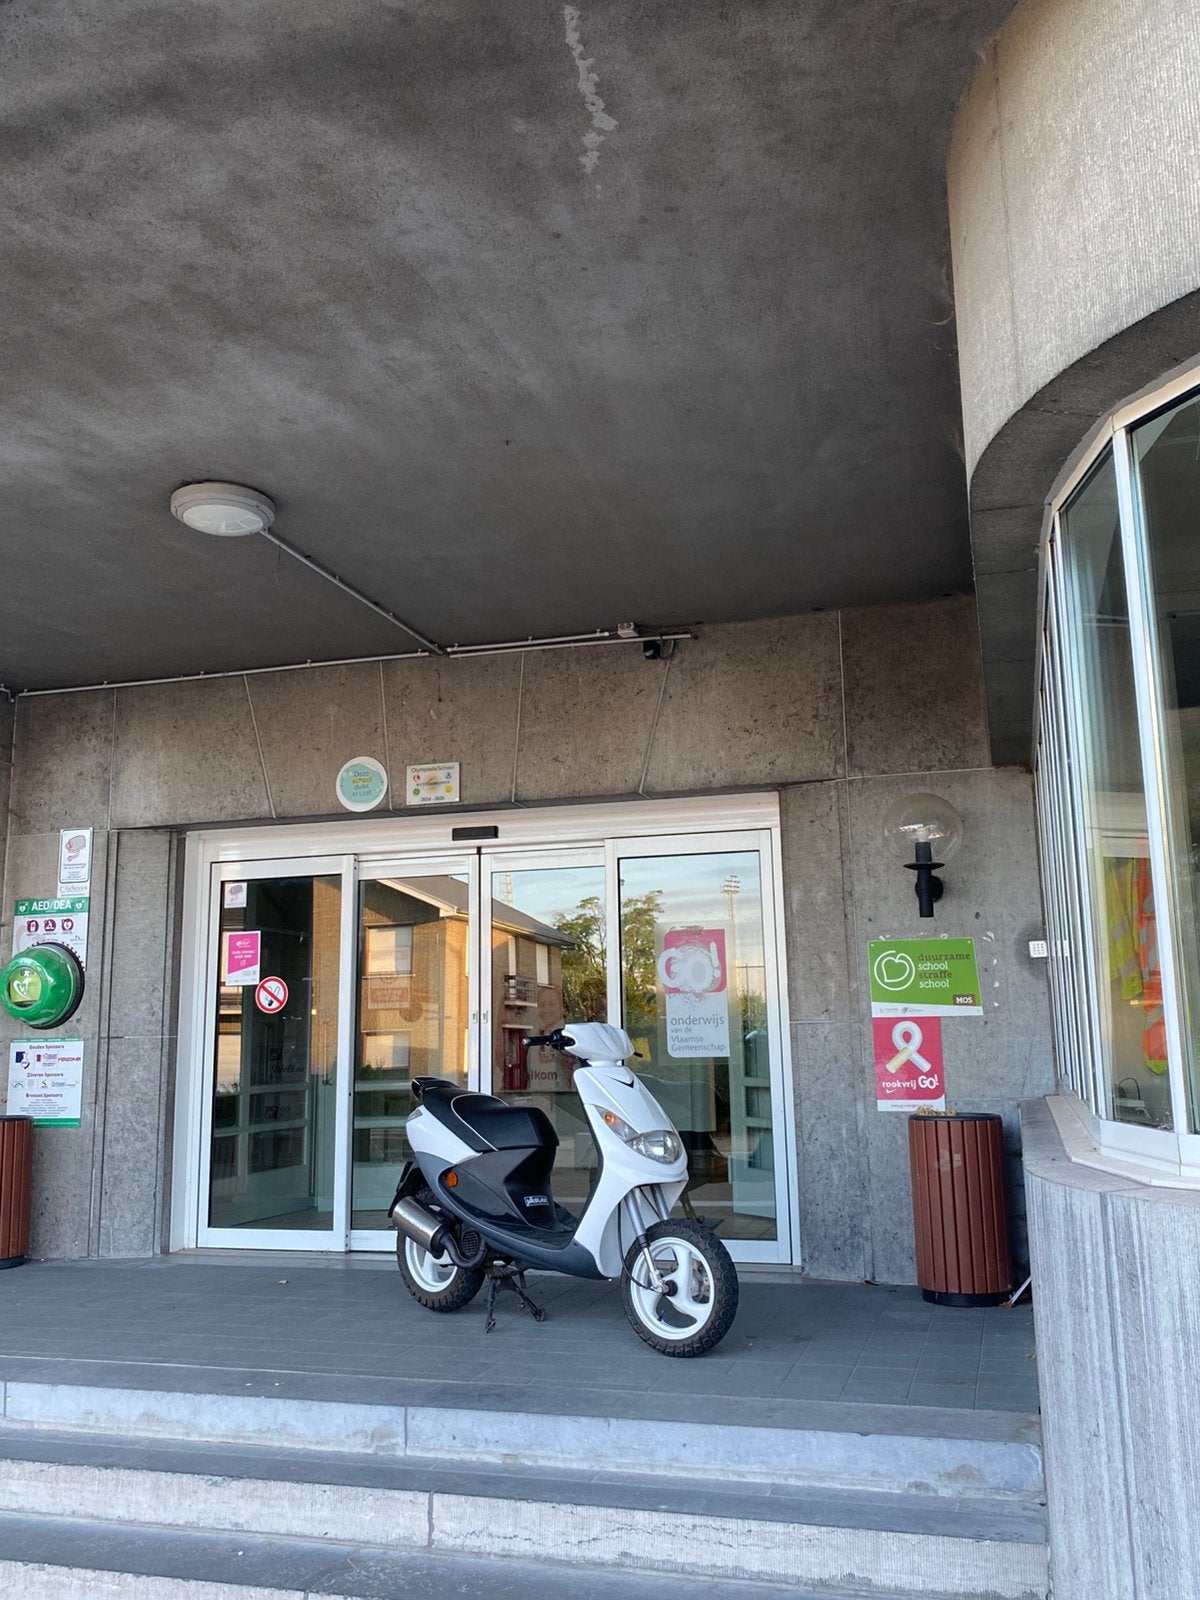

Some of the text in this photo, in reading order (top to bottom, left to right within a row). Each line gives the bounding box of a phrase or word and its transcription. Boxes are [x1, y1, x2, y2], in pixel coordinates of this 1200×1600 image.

[352, 776, 373, 784] school
[31, 900, 72, 911] AED/DEA
[918, 952, 971, 961] duurzame
[918, 961, 948, 970] school
[919, 970, 953, 979] straffe
[919, 979, 950, 988] school
[956, 996, 973, 1004] MOS
[670, 1014, 725, 1028] onderwijs
[671, 1034, 704, 1042] Vlaamse
[671, 1043, 726, 1052] Gemeenschap
[882, 1073, 939, 1090] rookvrij GO!
